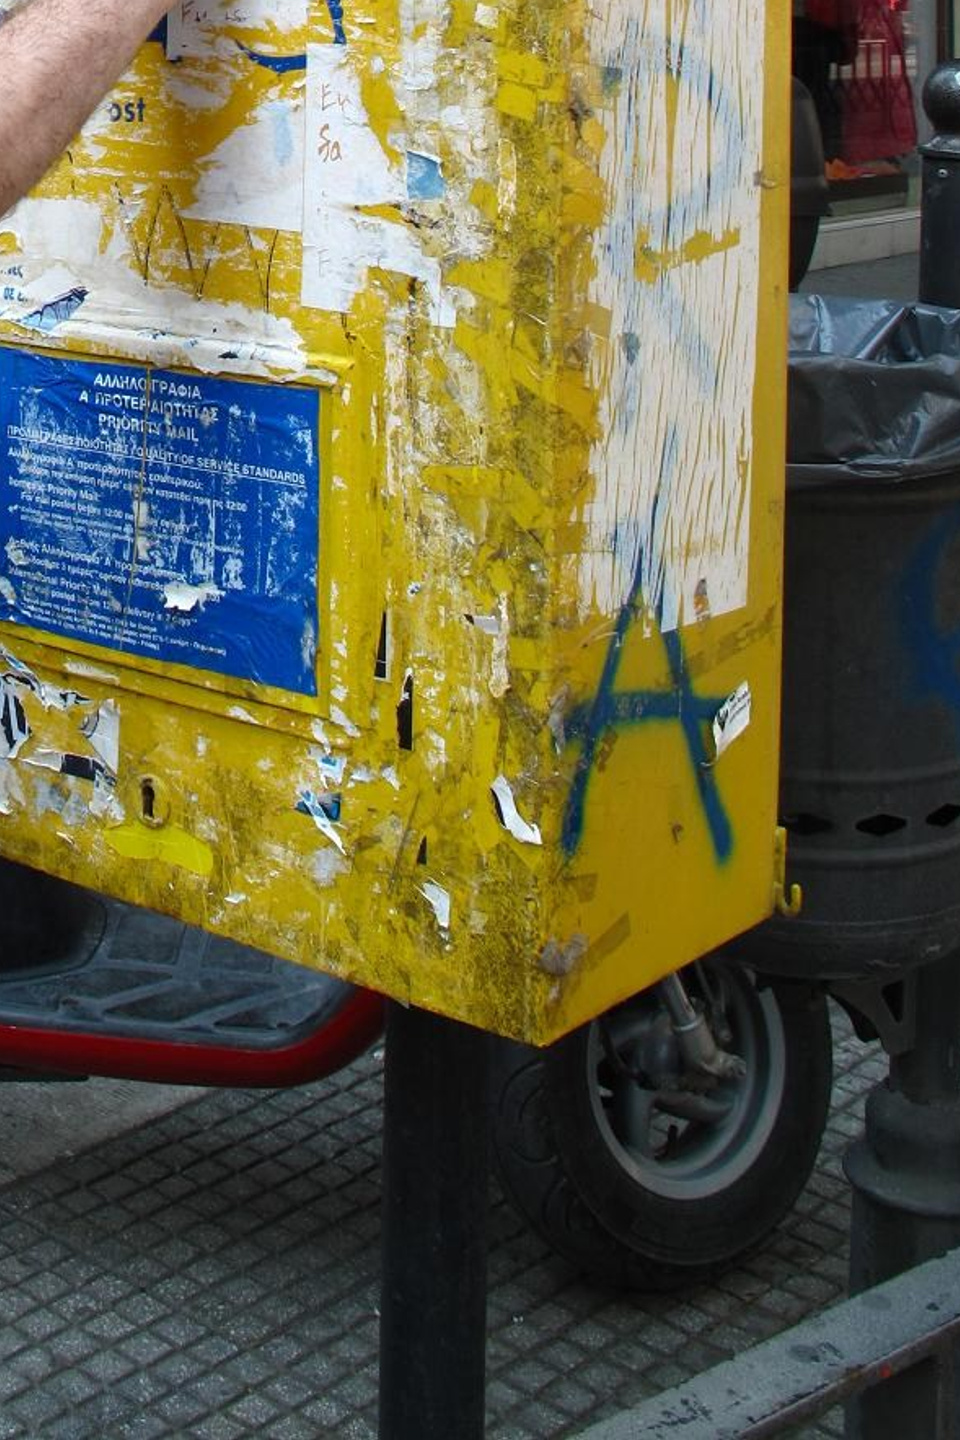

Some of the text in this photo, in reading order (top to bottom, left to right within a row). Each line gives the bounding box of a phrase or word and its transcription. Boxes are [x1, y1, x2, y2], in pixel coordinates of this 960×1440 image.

[107, 97, 145, 122] ost
[98, 412, 198, 442] PRIORITY MAIL
[241, 462, 305, 484] STANDARDS
